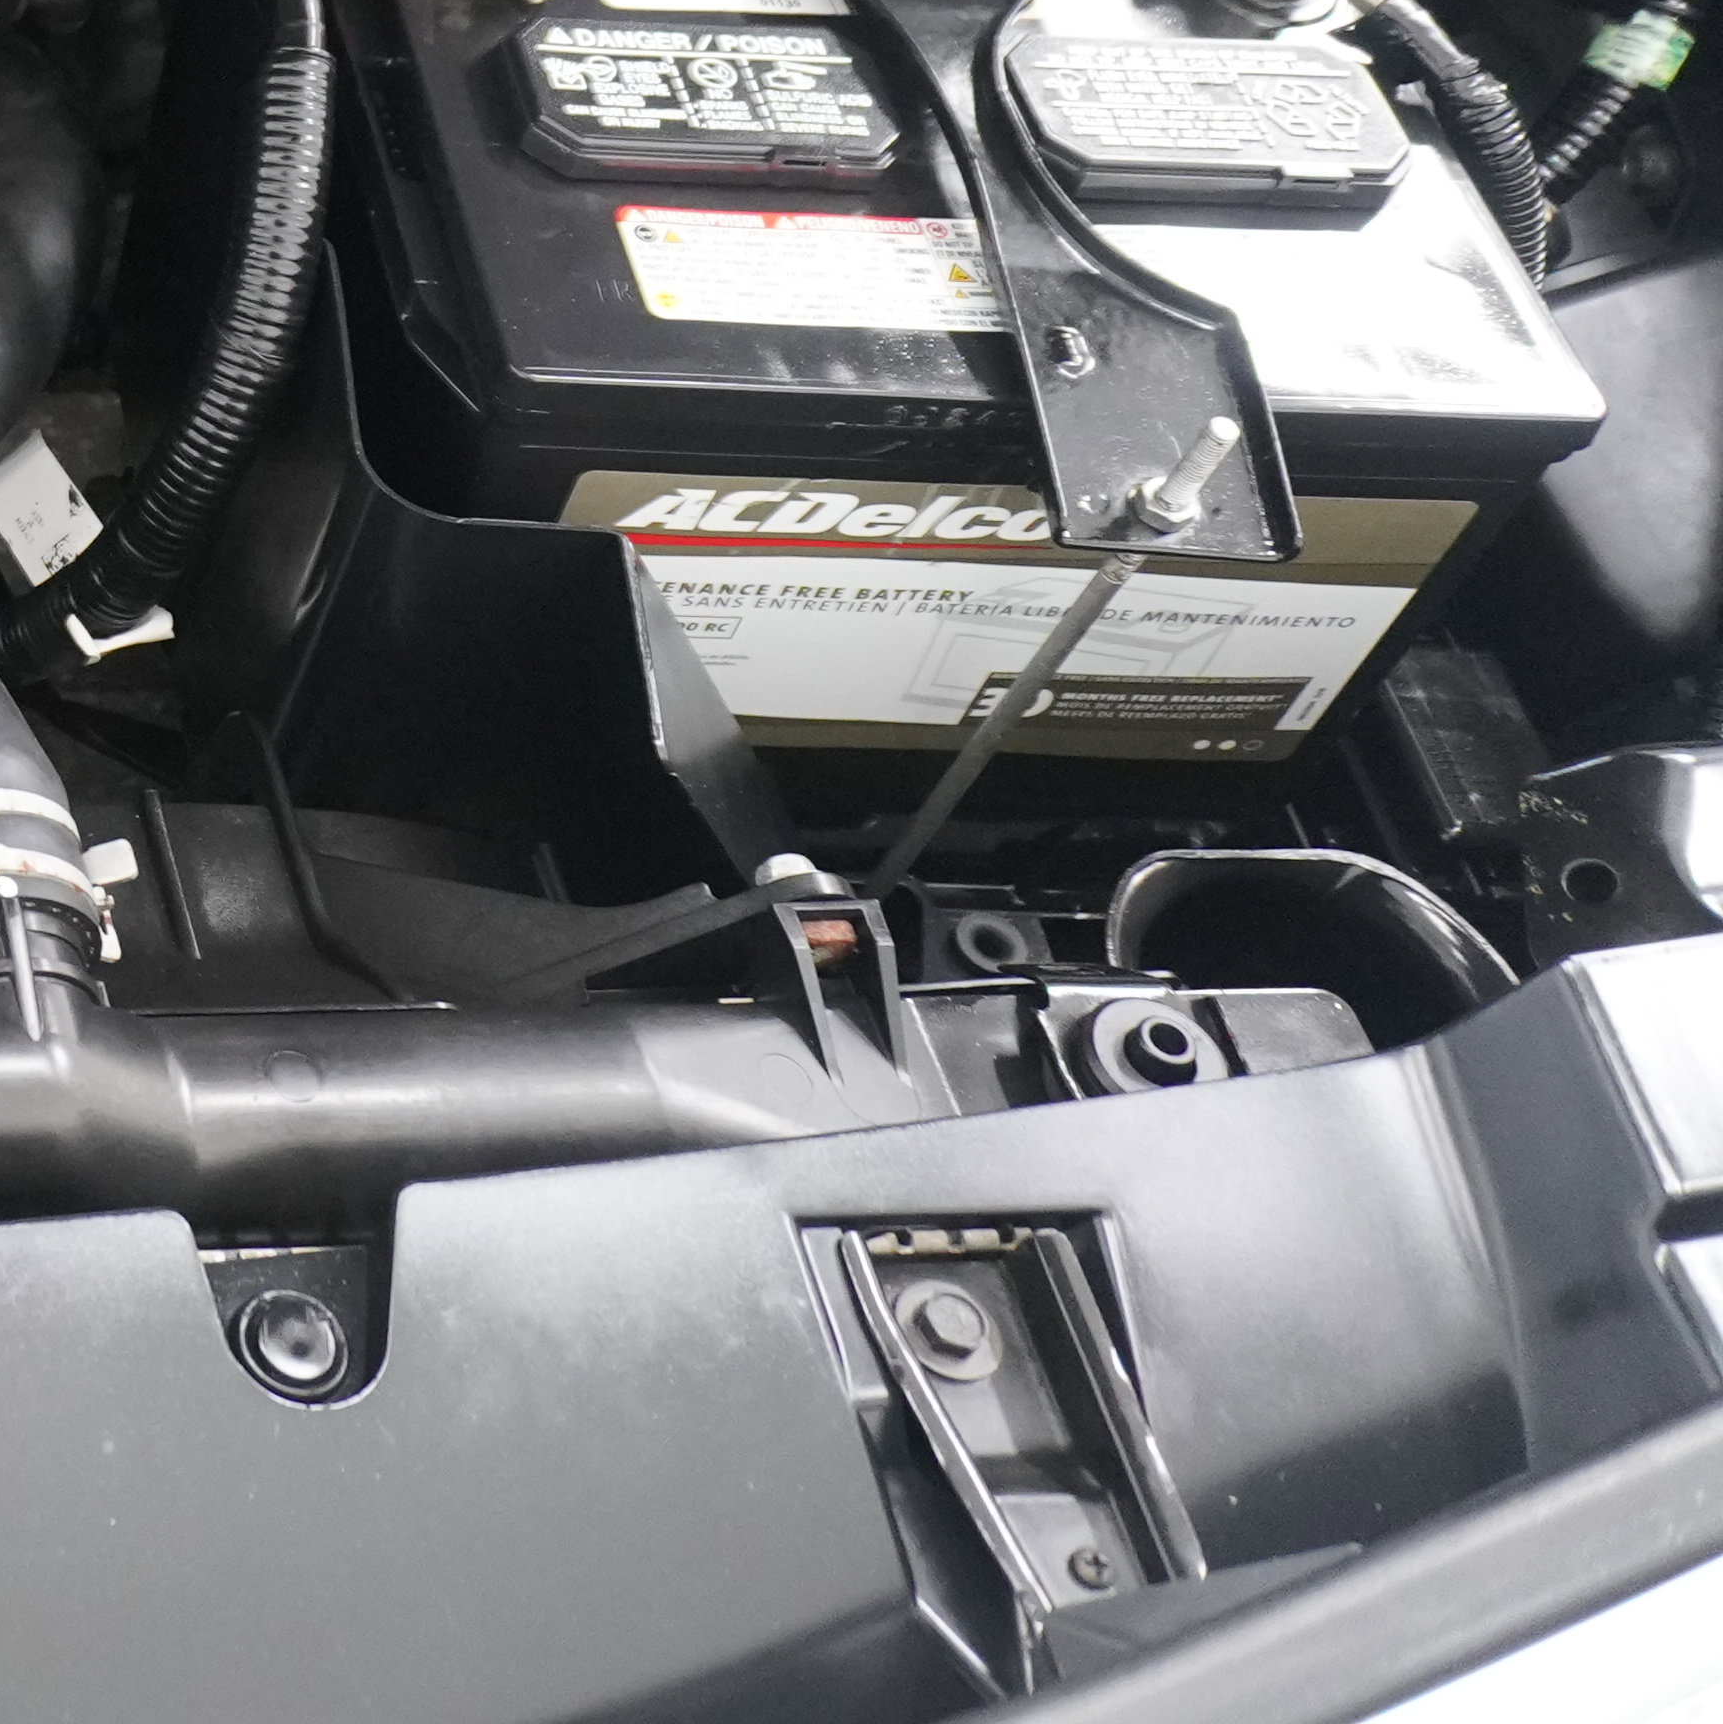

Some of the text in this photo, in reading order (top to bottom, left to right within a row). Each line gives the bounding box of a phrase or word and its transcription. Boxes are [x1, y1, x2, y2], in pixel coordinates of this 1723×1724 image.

[571, 27, 693, 52] DANGER
[715, 34, 828, 56] POISON
[615, 488, 1054, 541] ACDelco
[655, 581, 975, 604] ENANCE FREE BATTERY
[682, 596, 743, 609] SANS
[754, 597, 888, 614] ENTRETIEN
[1100, 609, 1132, 622] DE
[1140, 610, 1356, 630] MANTENIMIENTO
[704, 622, 730, 633] RC
